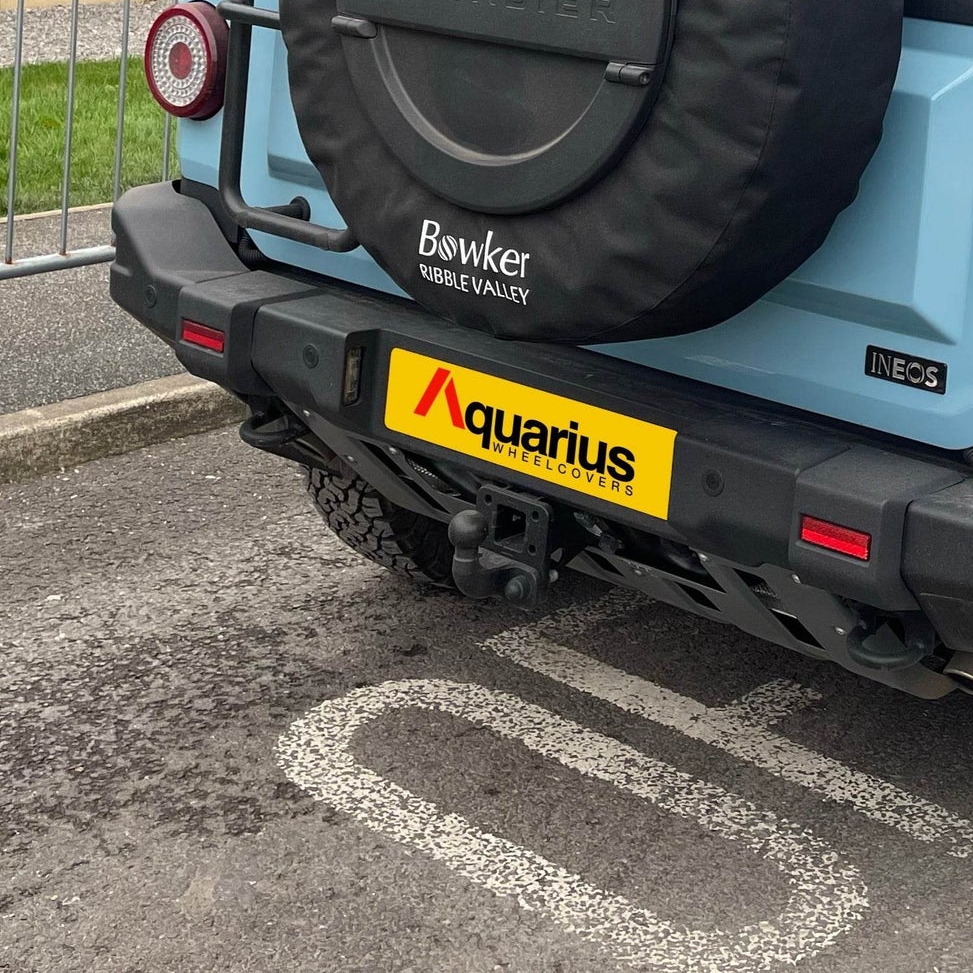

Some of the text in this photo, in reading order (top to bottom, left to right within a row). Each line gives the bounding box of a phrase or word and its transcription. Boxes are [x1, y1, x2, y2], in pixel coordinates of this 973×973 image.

[418, 219, 530, 278] Bowker
[419, 263, 530, 306] RIBBLE VALLEY
[870, 352, 939, 388] INEOS
[413, 367, 636, 483] Aquarius
[492, 441, 634, 497] WHEELCOVERS
